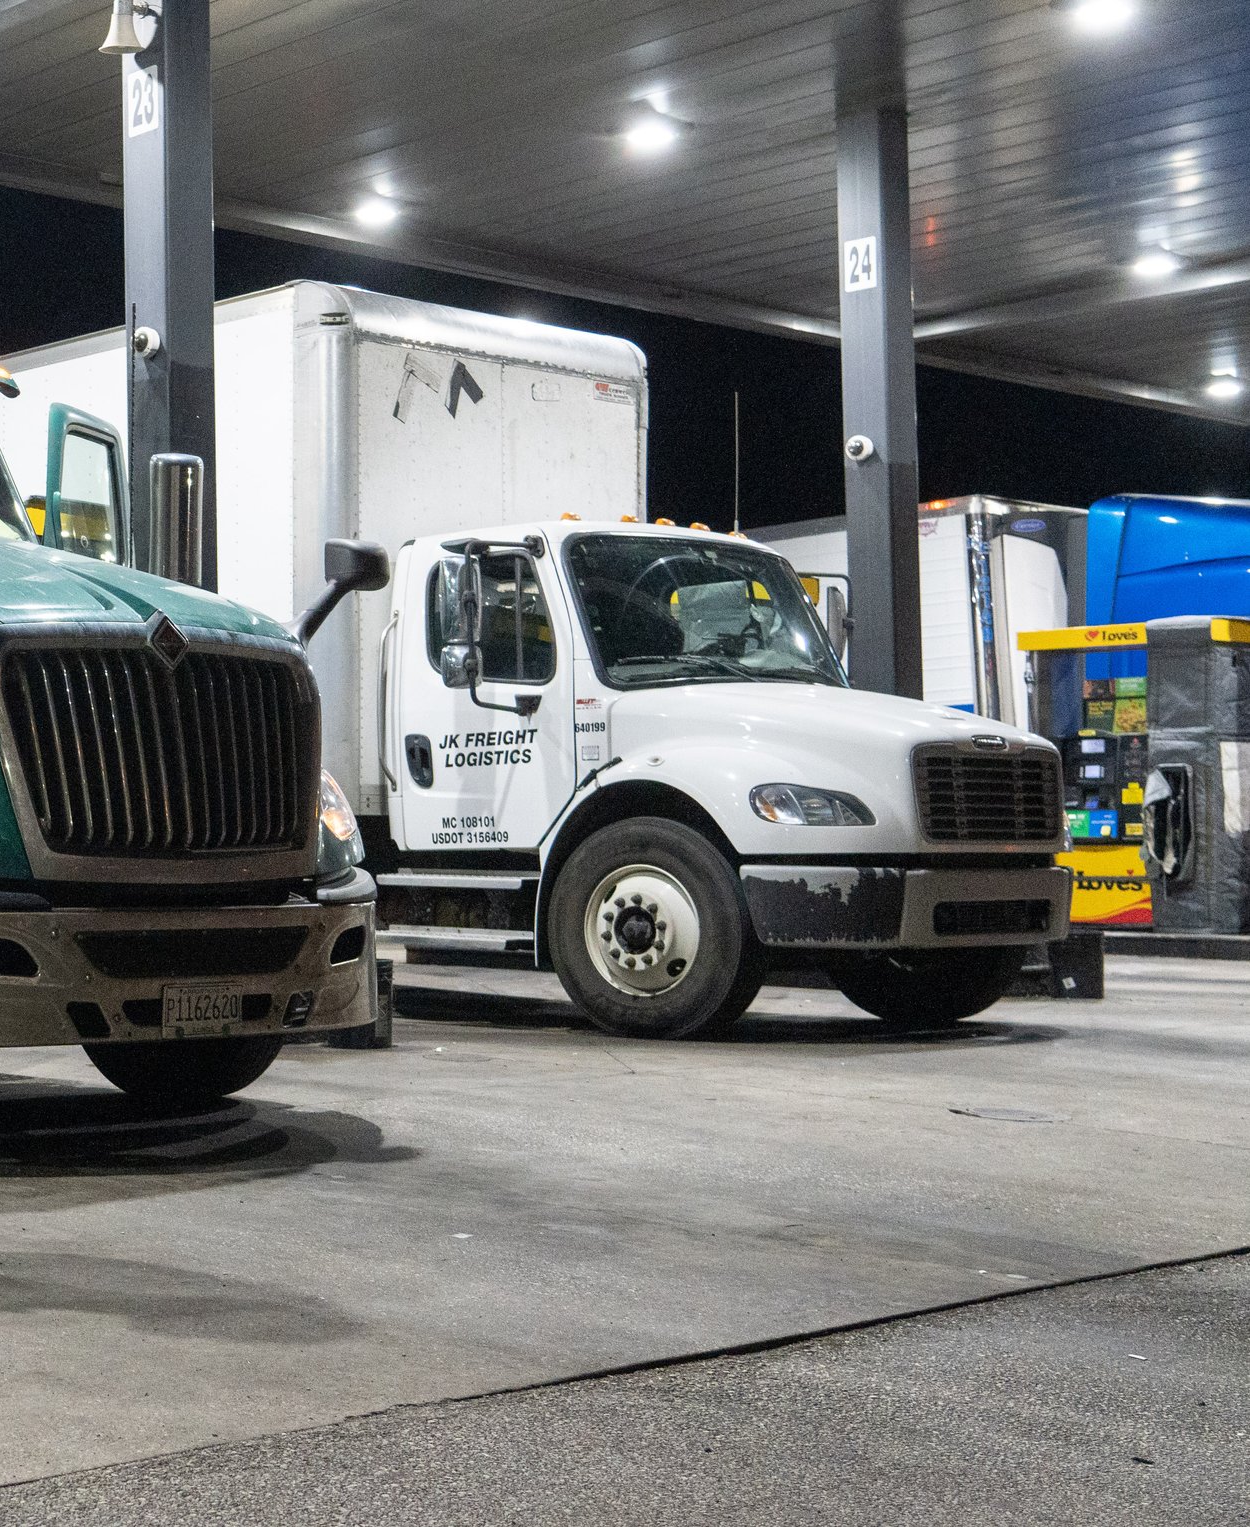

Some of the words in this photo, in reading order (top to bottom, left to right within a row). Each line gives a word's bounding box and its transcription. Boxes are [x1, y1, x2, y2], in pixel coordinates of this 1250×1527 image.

[132, 73, 154, 128] 23
[849, 244, 872, 284] 24
[574, 721, 606, 733] 640199
[439, 733, 460, 749] JK
[465, 728, 538, 748] FREIGHT
[445, 748, 532, 768] LOGISTICS
[442, 816, 457, 829] MC
[460, 815, 495, 828] 108101
[431, 832, 463, 844] USDOT
[466, 831, 509, 843] 3156409
[165, 993, 238, 1023] P1162620
